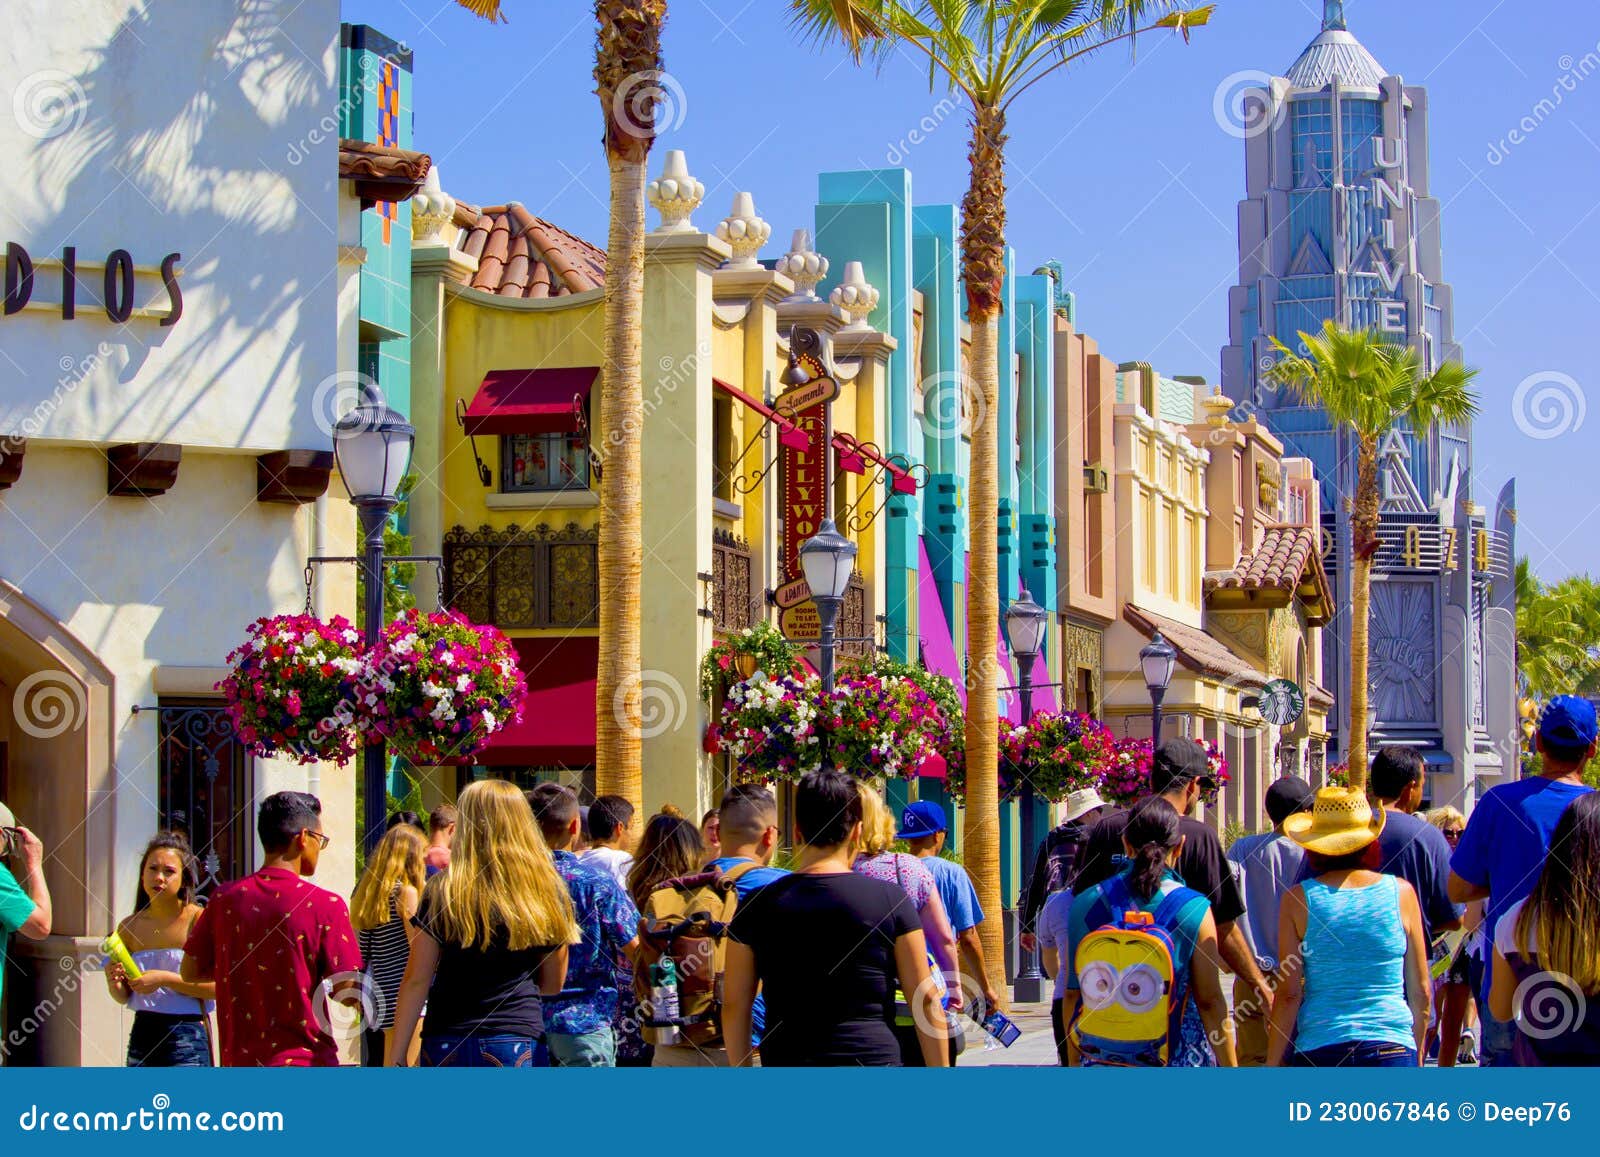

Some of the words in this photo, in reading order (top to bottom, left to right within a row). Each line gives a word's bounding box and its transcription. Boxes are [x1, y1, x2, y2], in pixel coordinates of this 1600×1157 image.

[4, 241, 184, 327] DIOS
[1370, 135, 1411, 501] UNIVEAL
[791, 416, 820, 572] HLLYWO
